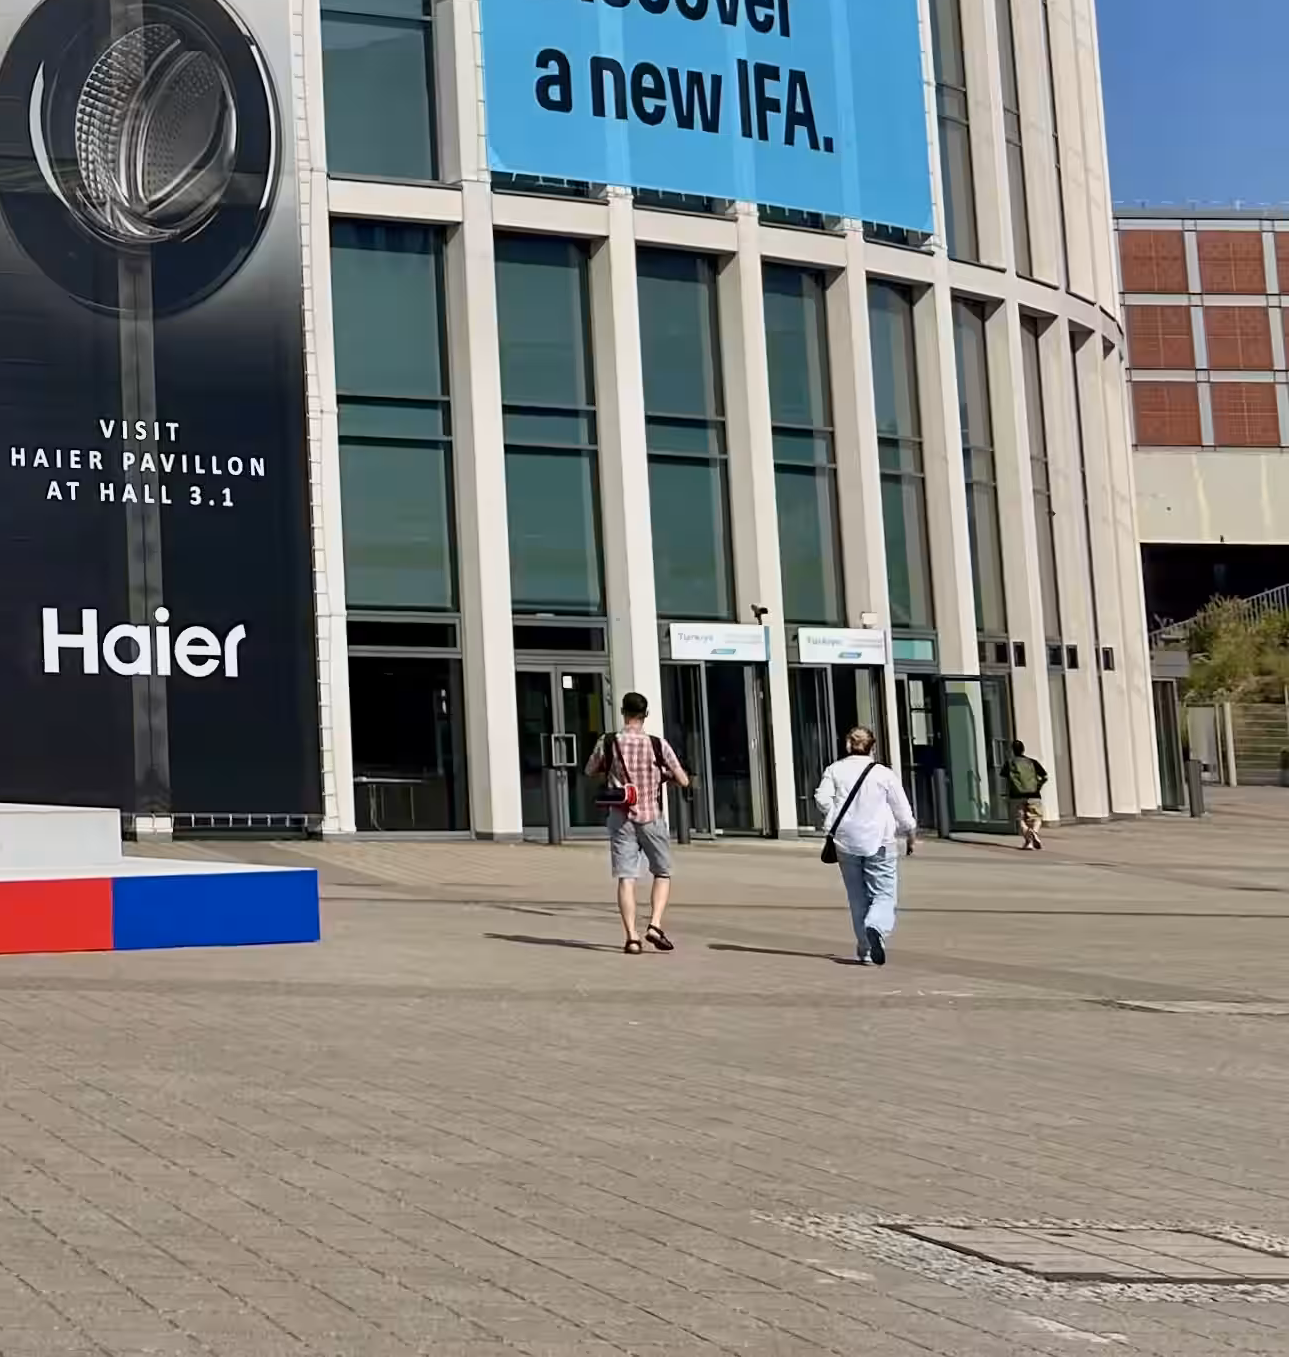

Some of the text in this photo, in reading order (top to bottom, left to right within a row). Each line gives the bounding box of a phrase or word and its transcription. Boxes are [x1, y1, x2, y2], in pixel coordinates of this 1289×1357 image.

[535, 47, 835, 154] a new IFA.
[99, 418, 180, 442] VISIT
[10, 447, 266, 477] HAIER PAVILLON
[46, 480, 235, 507] AT HALL 3.1
[42, 606, 247, 678] Haier
